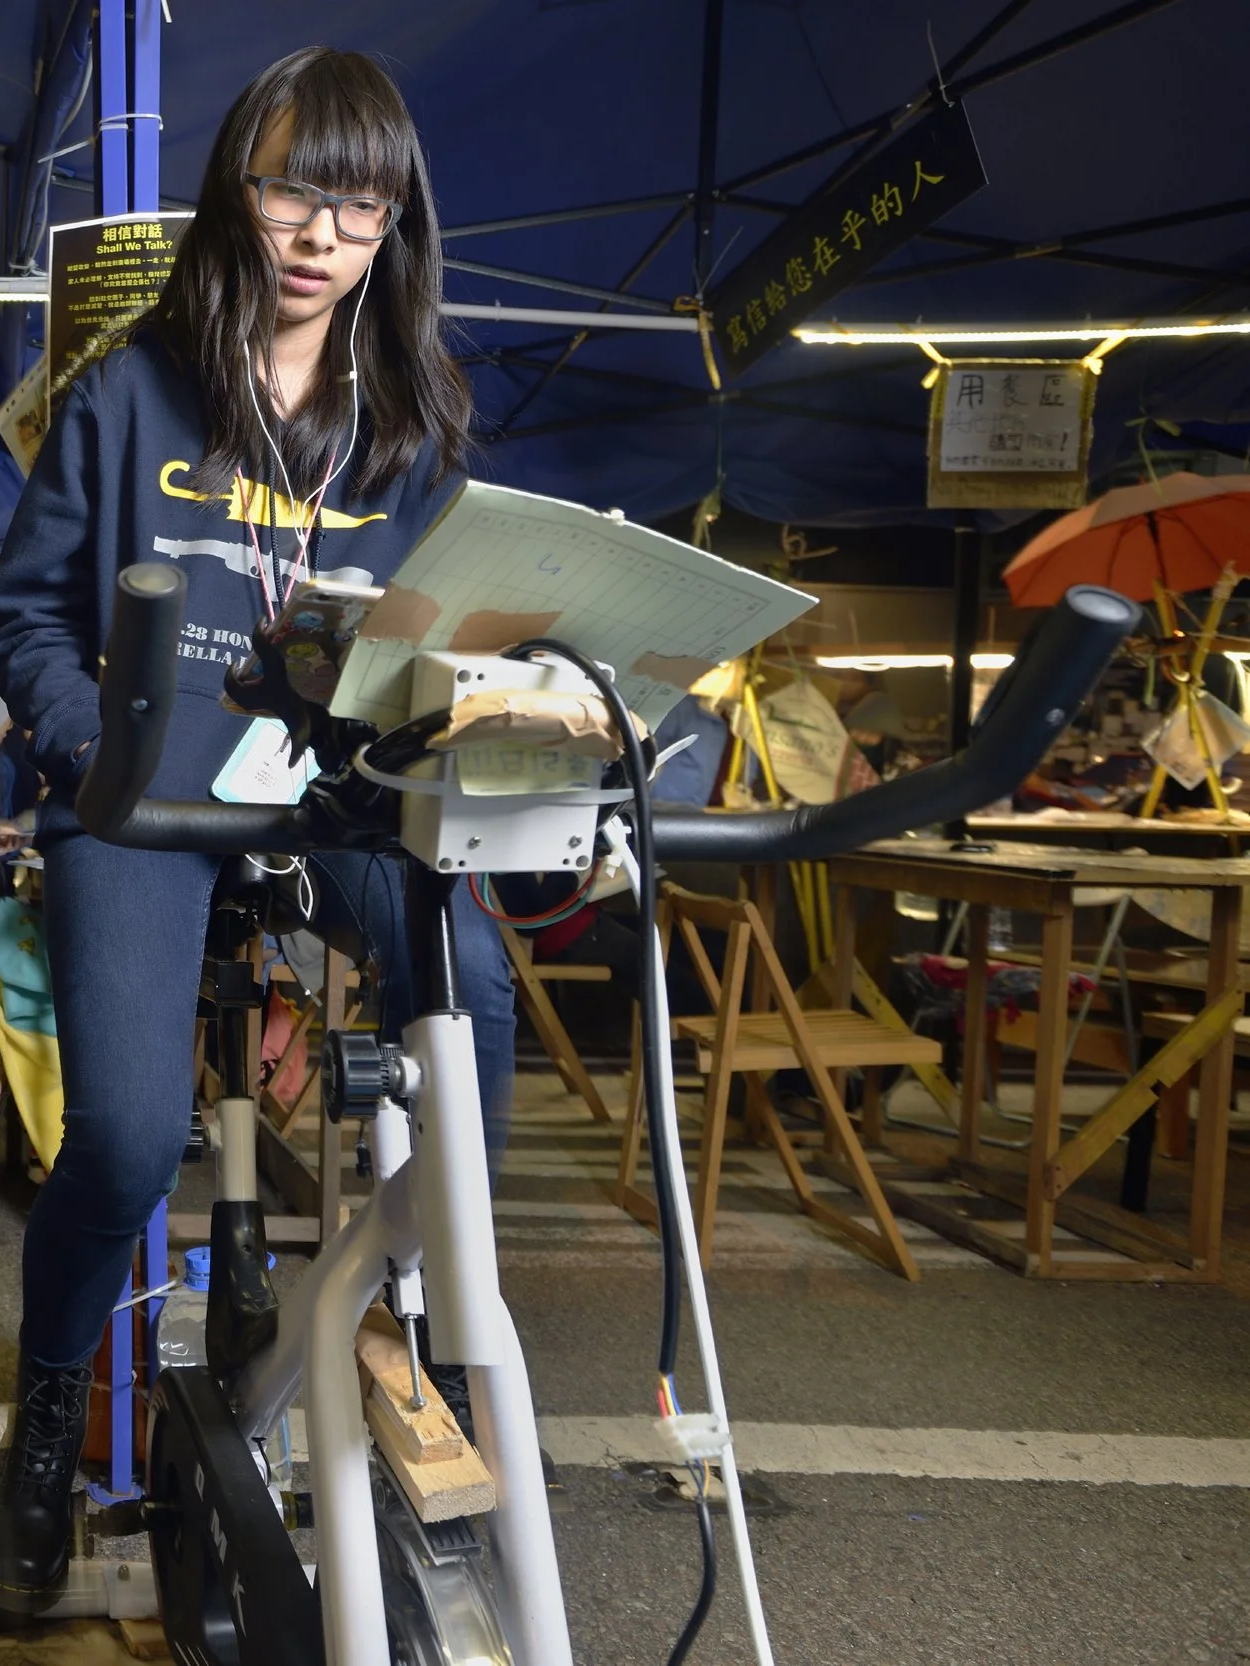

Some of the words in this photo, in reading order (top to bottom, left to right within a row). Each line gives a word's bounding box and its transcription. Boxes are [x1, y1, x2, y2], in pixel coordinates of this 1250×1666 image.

[103, 223, 163, 242] 相信對話
[96, 242, 123, 254] Shall
[125, 241, 142, 252] We
[144, 240, 173, 250] Talk?
[726, 161, 945, 354] 寫信給您在乎的人
